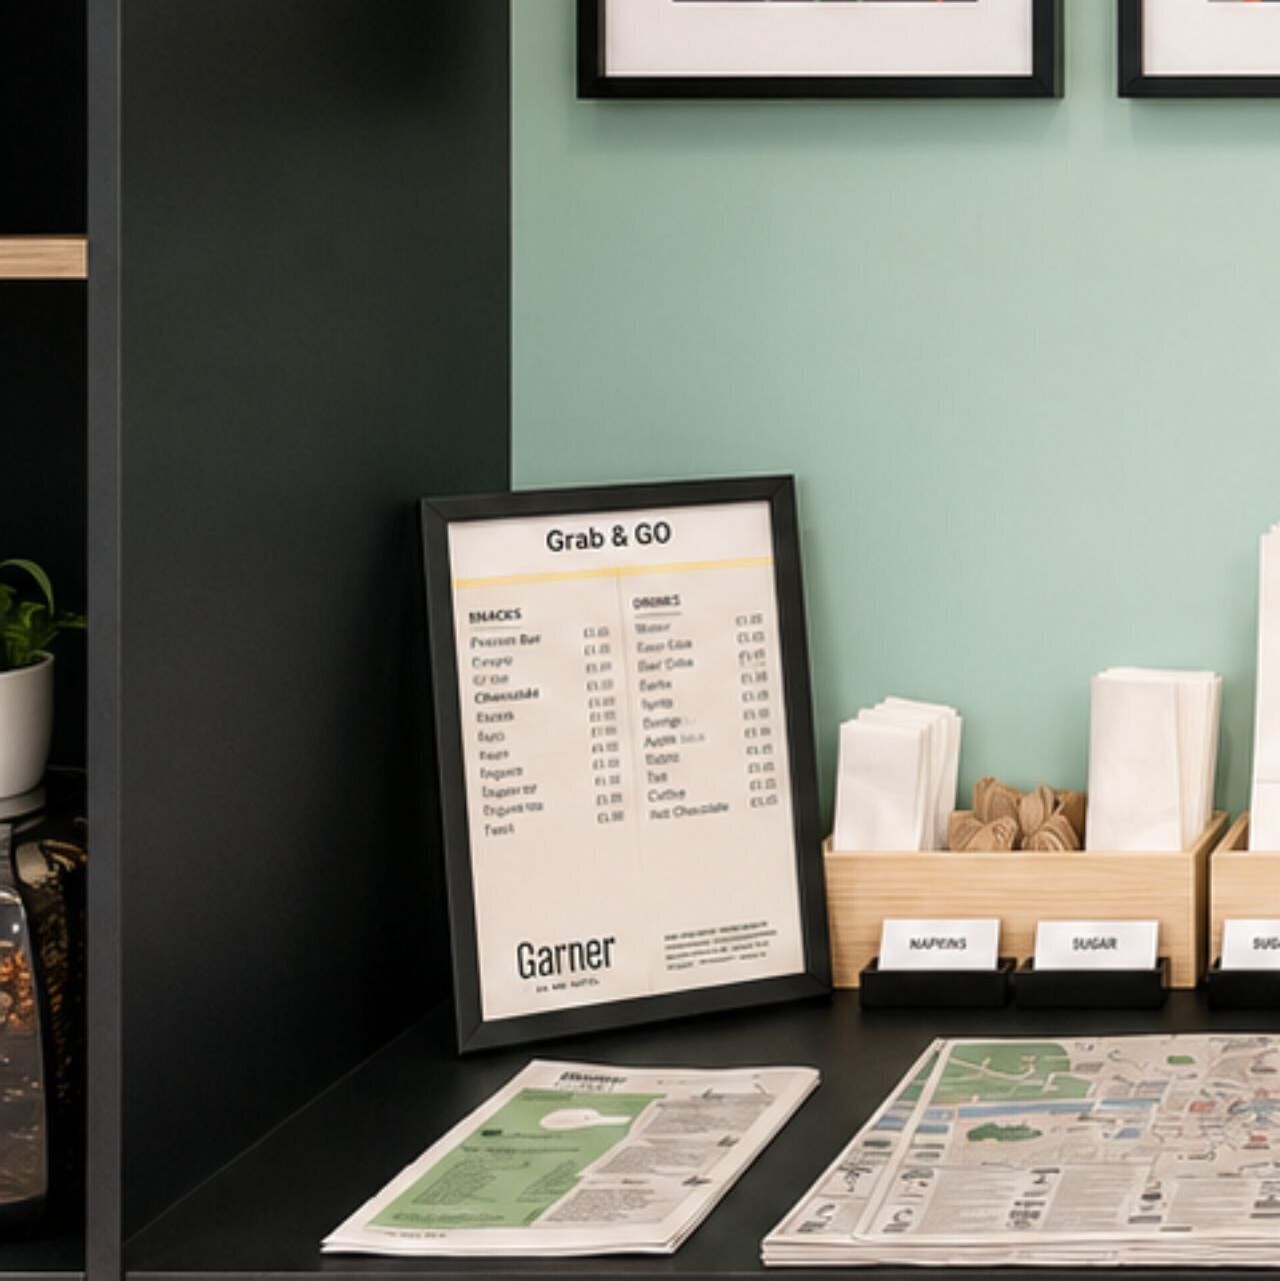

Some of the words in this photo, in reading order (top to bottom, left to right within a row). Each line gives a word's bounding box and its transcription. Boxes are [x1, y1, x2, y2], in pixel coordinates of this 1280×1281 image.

[546, 526, 604, 553] Grab
[611, 524, 628, 547] &
[634, 521, 672, 545] GO
[516, 935, 617, 980] Garner
[1072, 937, 1118, 950] SUGAR
